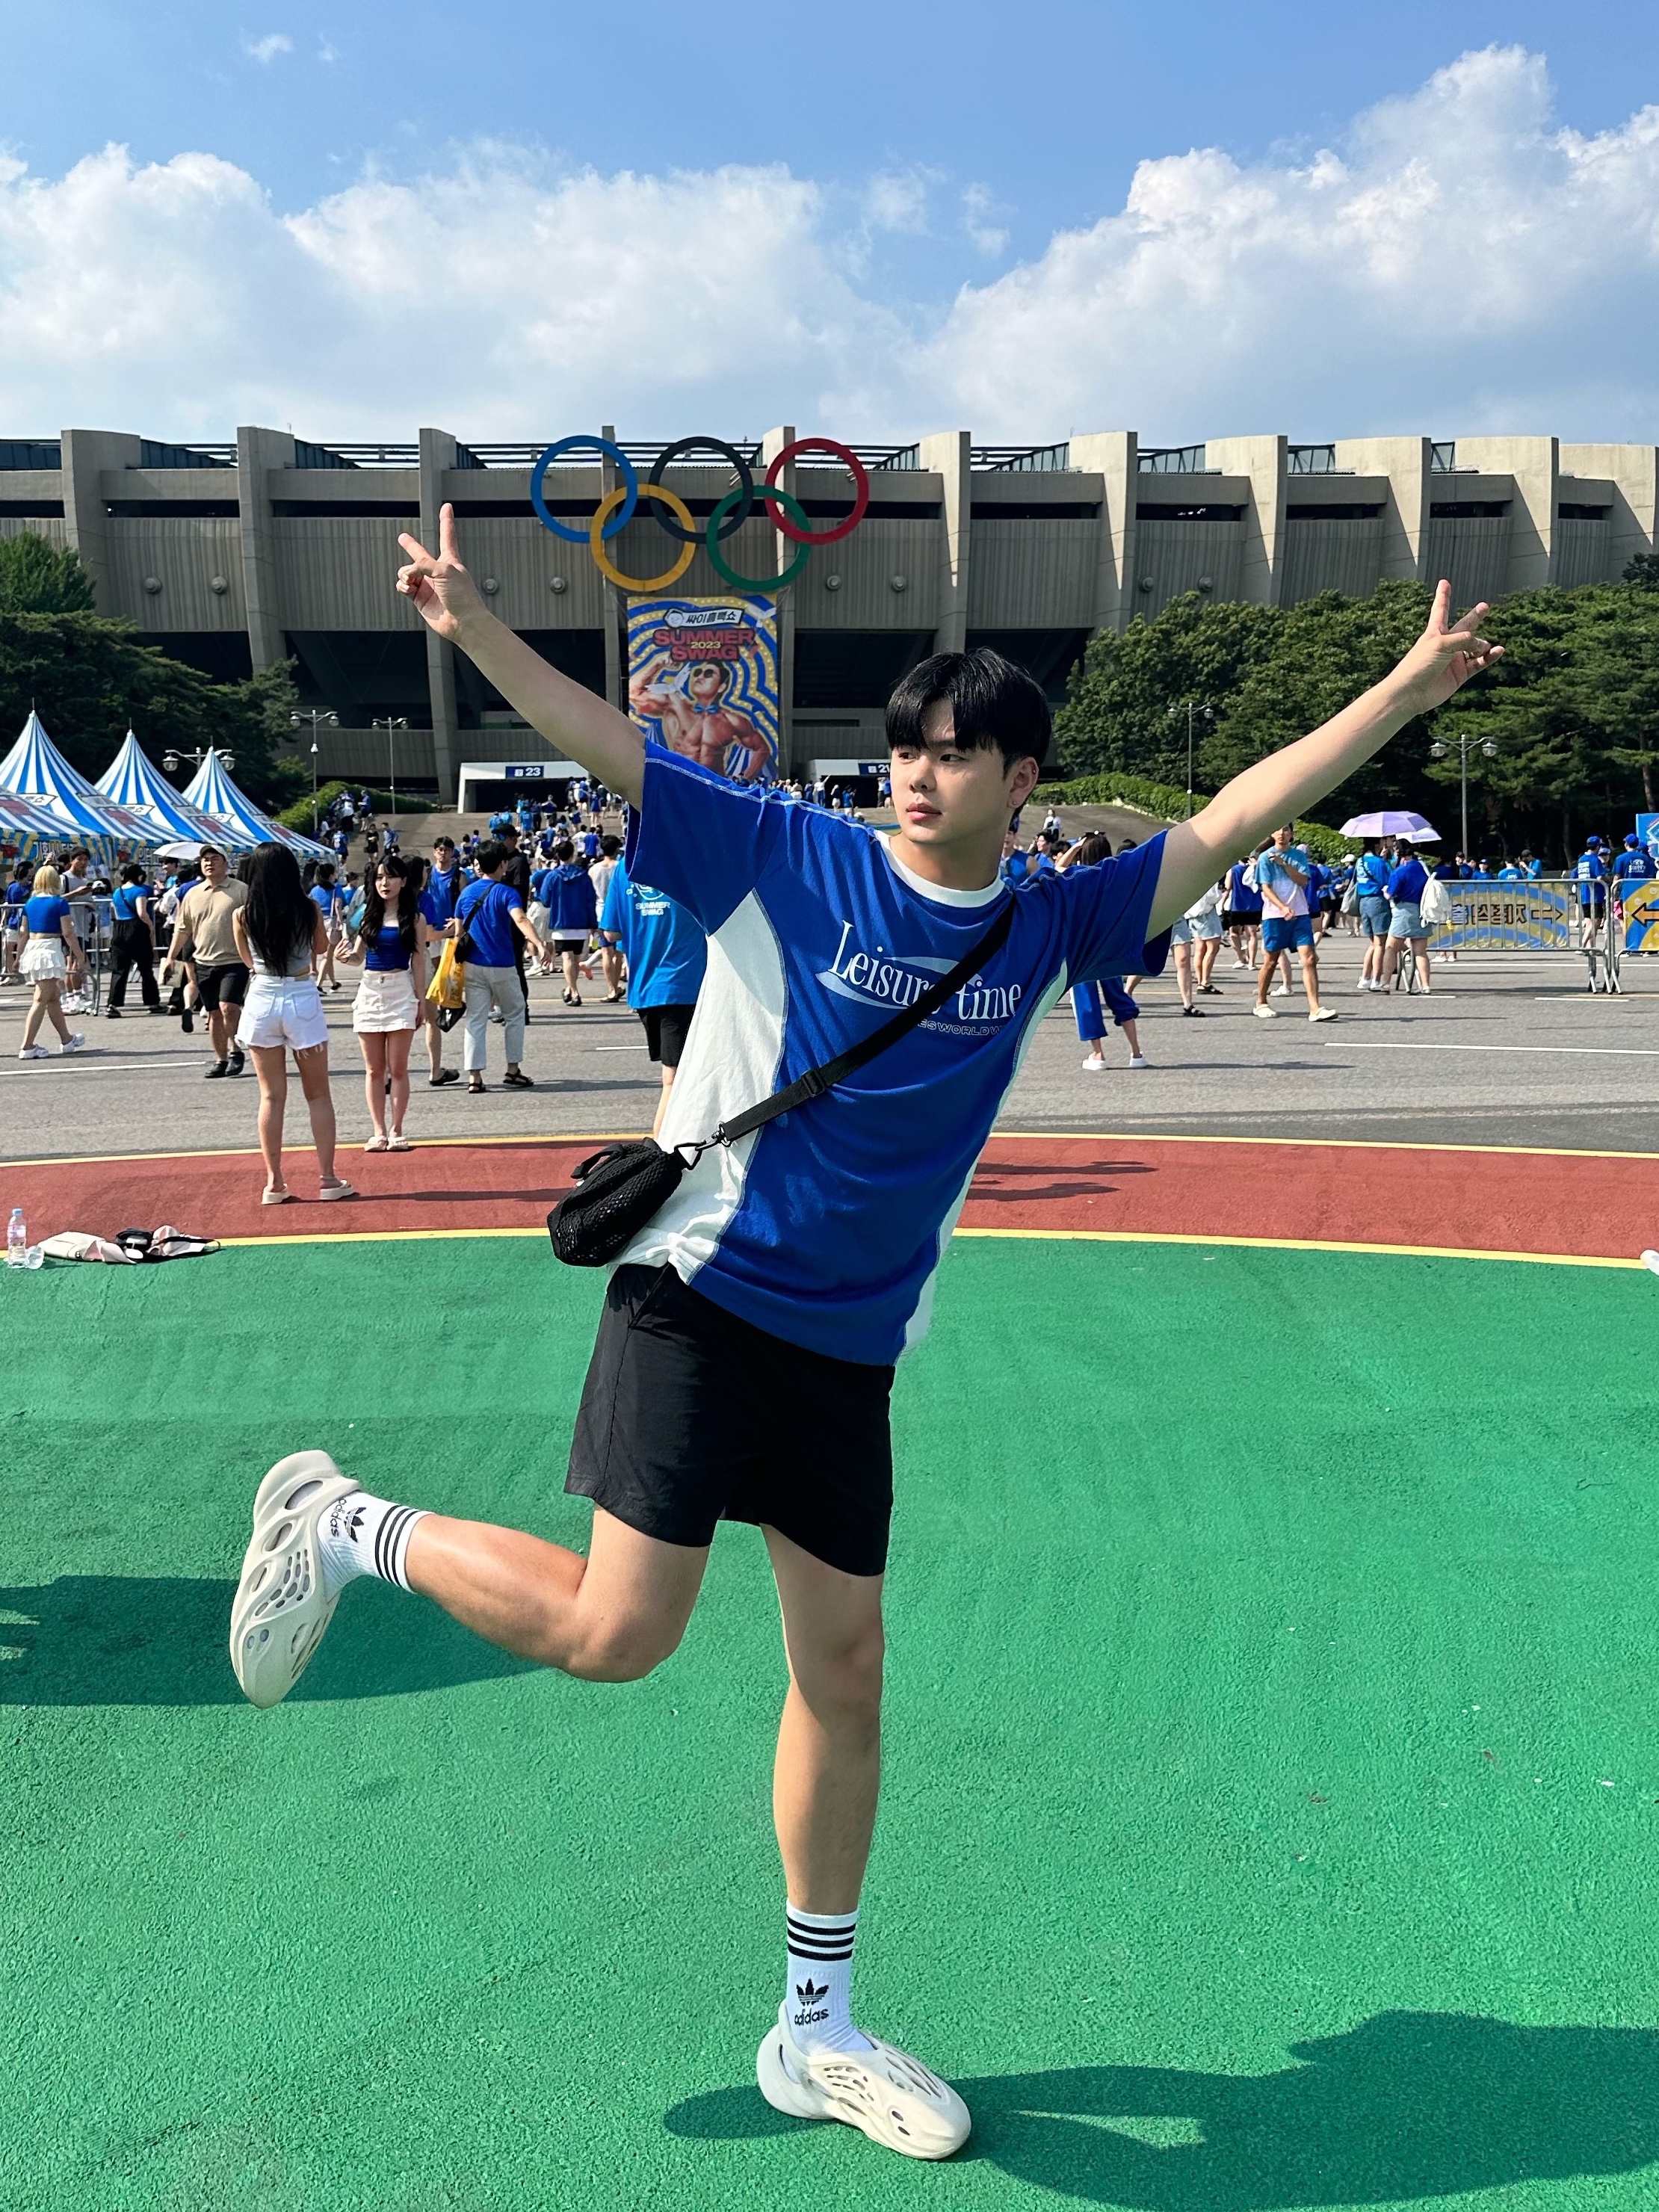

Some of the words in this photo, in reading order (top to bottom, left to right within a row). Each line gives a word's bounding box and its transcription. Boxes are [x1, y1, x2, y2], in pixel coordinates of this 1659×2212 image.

[654, 629, 754, 646] SUMMER
[691, 641, 721, 649] 2023
[672, 644, 738, 661] SWAG
[525, 767, 541, 776] 23
[635, 901, 670, 909] SUMMER
[827, 919, 941, 1014] Leisur
[955, 983, 1022, 1020] time
[330, 1498, 347, 1537] adidas
[794, 2008, 830, 2027] adidas
